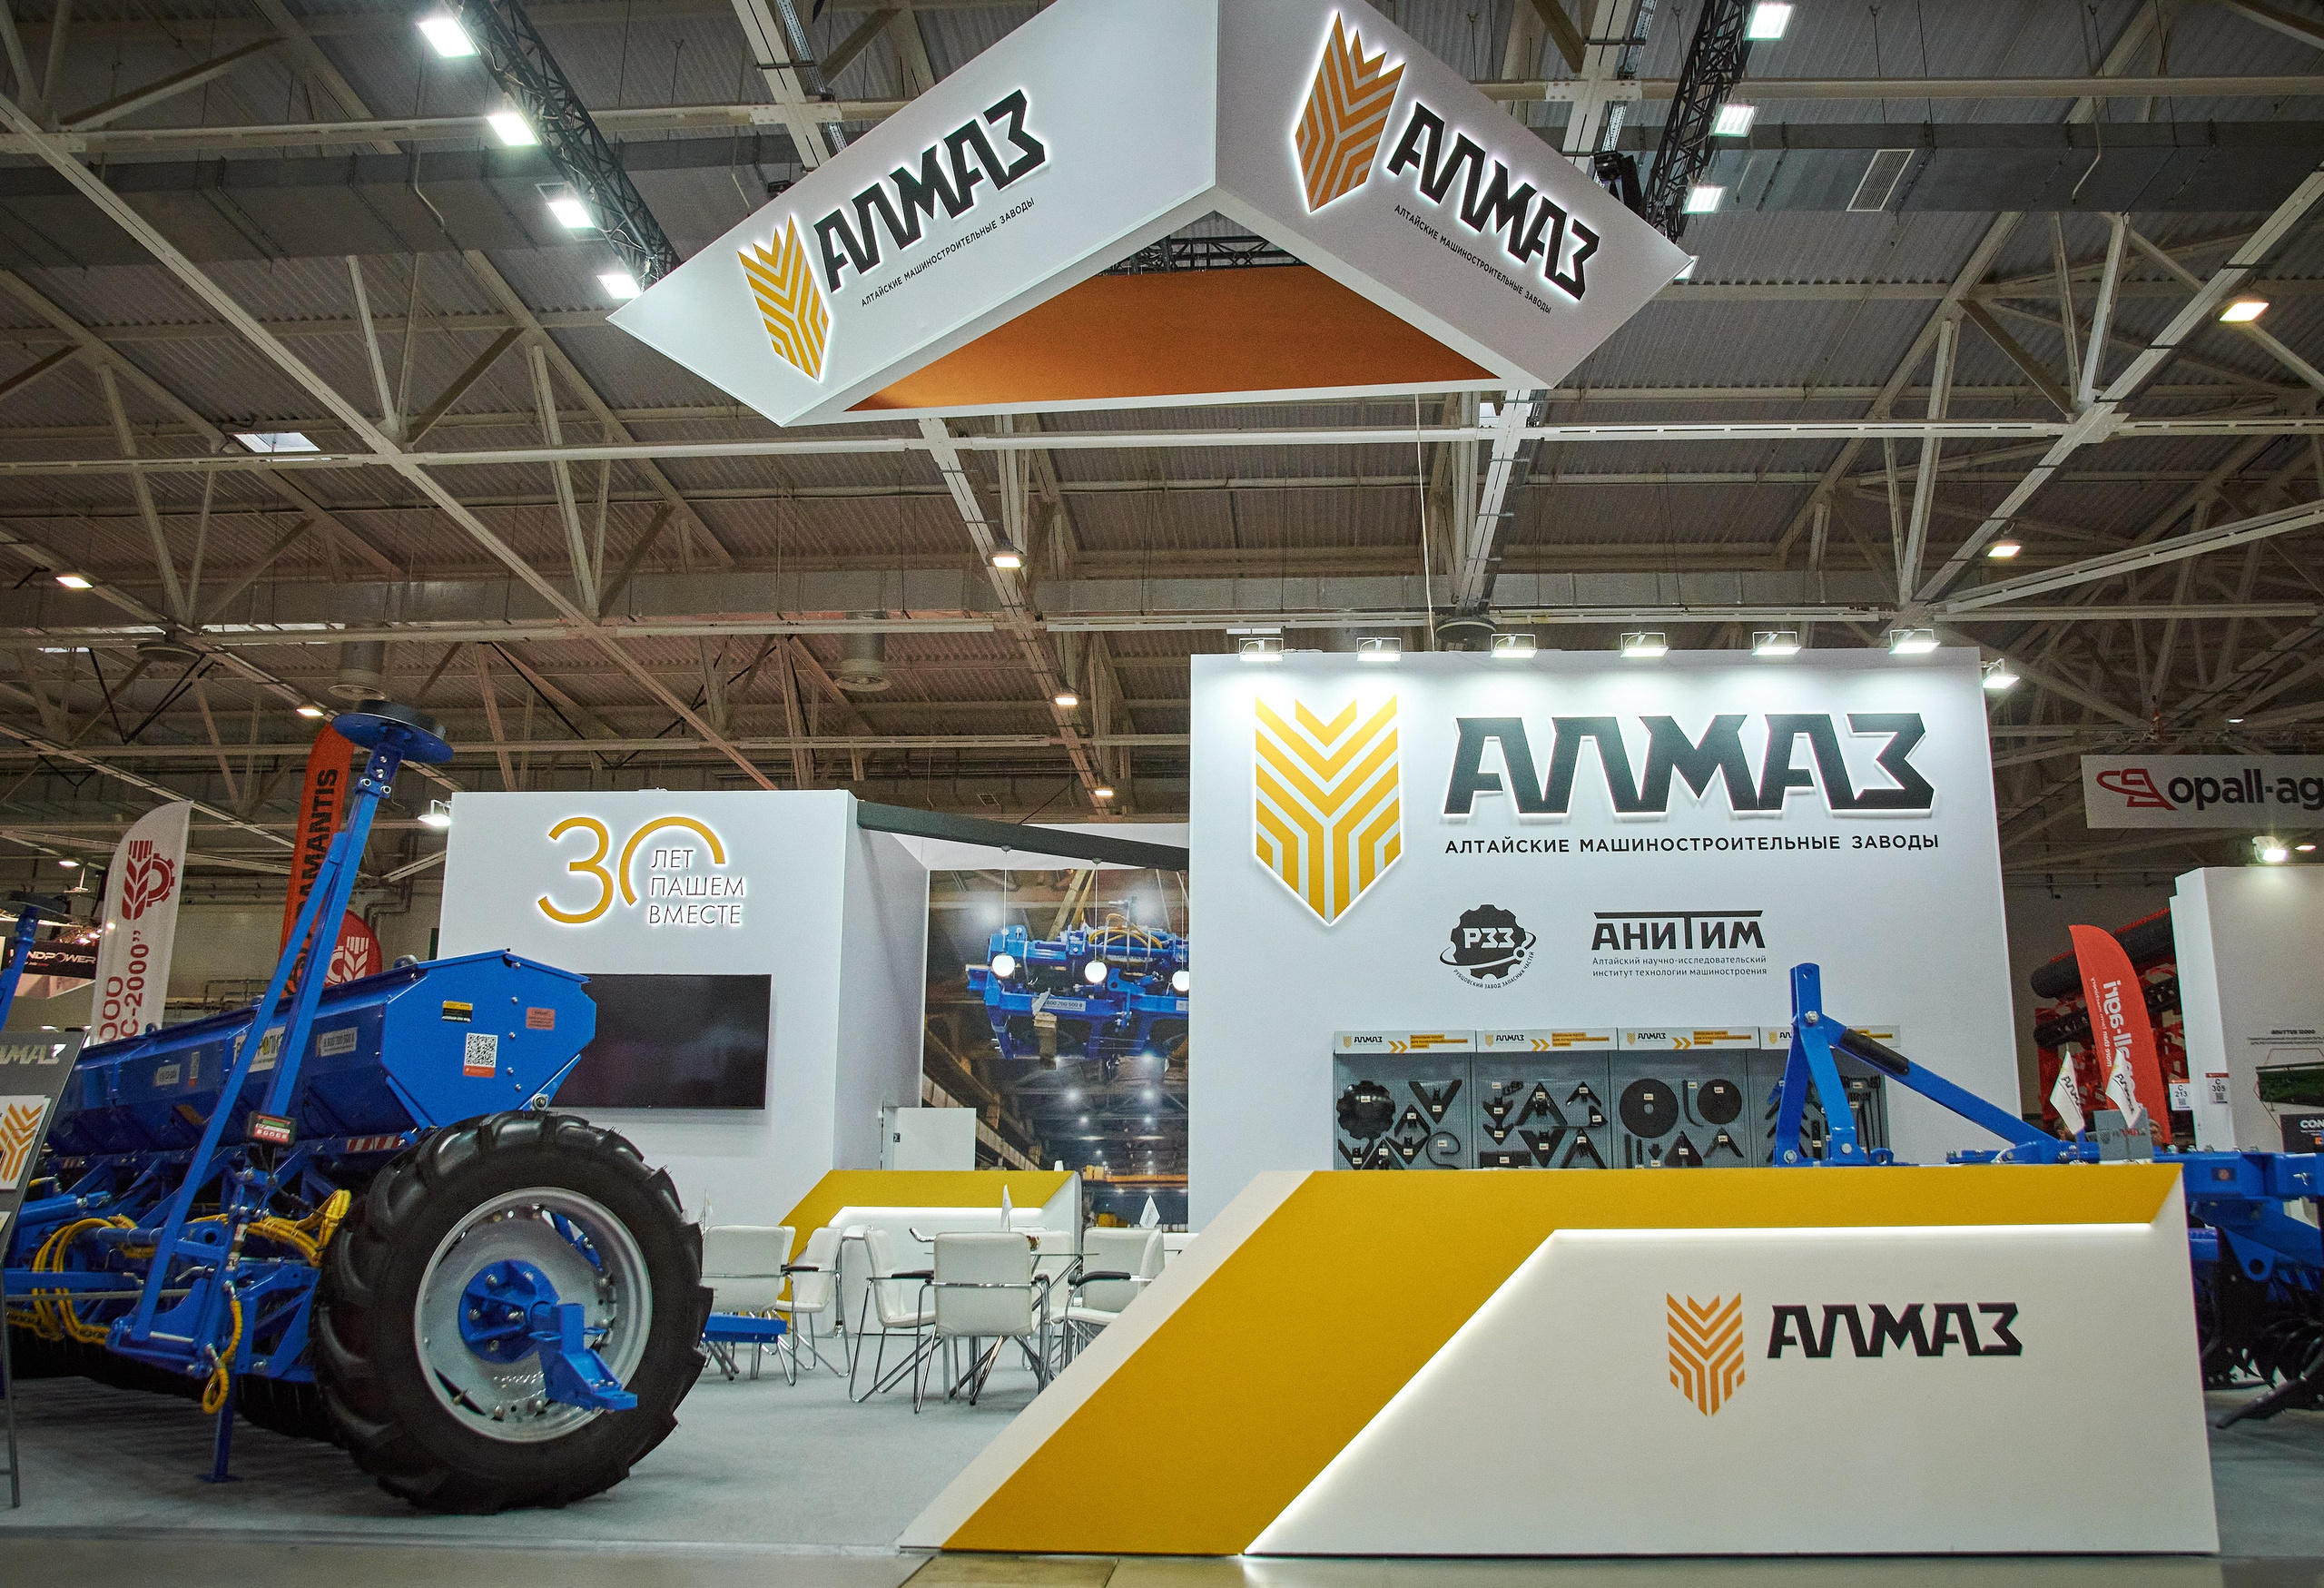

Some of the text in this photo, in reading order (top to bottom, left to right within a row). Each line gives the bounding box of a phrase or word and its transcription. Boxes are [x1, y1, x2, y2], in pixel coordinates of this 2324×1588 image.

[813, 89, 1046, 293] АЛМАЗ
[1386, 101, 1600, 301] АЛМАЗ
[862, 197, 1035, 307] АЛТАЙСКИЕ МАШИНОСТРОИТЕЛЬНЫЕ ЗАВОДЫ
[1394, 204, 1551, 314] АЛТАЙСКИЕ МАШИНОСТРОИТЕЛЬНЫЕ ЗАВОДЫ
[1443, 713, 1935, 814] АЛМАЗ
[2168, 768, 2324, 811] opall-ag
[651, 849, 694, 868] ЛЕТ
[1445, 834, 1939, 853] АЛТАЙСКИЕ МАШИНОСТРОИТЕЛЬНЫЕ ЗАВОДЫ
[537, 816, 725, 923] 30
[650, 877, 743, 896] ПАШЕМ
[649, 905, 741, 924] ВМЕСТЕ
[1591, 910, 1766, 951] АНИТИМ
[10, 948, 97, 963] NDPOWER
[1592, 955, 1767, 967] Алтайский научно-исследовательский
[1592, 967, 1768, 978] институт технологии машиностроения
[1767, 1302, 2023, 1359] АЛМАЗ
